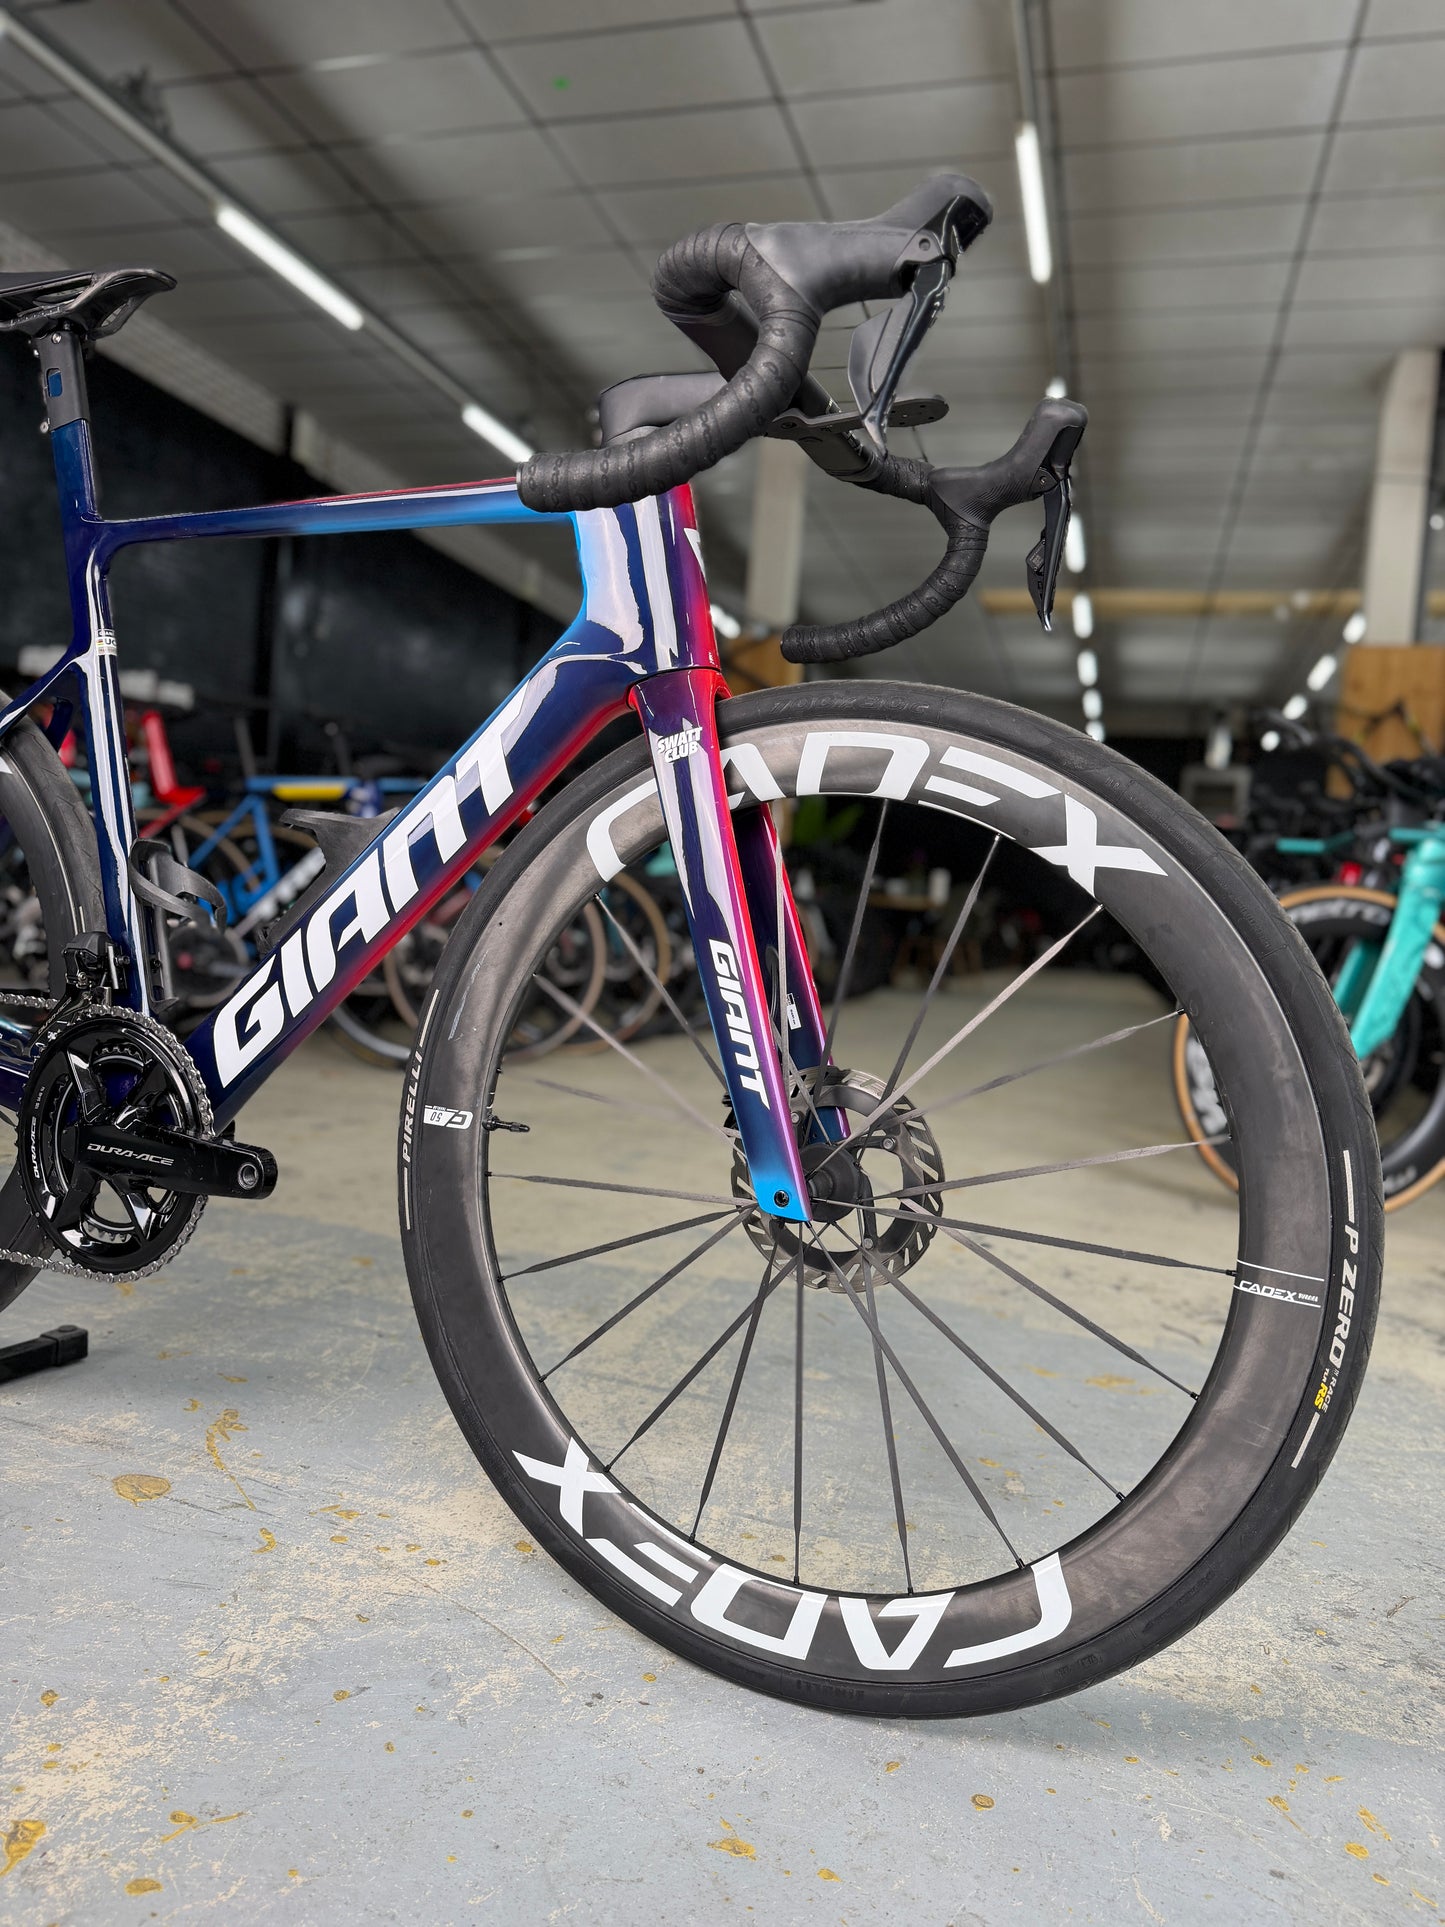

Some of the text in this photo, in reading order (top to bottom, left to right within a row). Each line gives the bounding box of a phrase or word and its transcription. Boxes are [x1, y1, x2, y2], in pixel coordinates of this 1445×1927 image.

[657, 726, 703, 754] SWATT
[664, 740, 699, 763] CLUB
[586, 731, 1168, 898] CADEX
[213, 679, 529, 1089] GIANT
[708, 938, 770, 1110] GIANT
[402, 1051, 423, 1163] PIRELLI
[430, 1111, 443, 1122] 50
[30, 1116, 40, 1179] DURA-ACE
[87, 1142, 175, 1166] DURA-ACE
[1239, 1280, 1298, 1302] CADEX
[1329, 1224, 1359, 1369] P ZERO
[1314, 1382, 1328, 1410] RS
[1321, 1376, 1337, 1413] RACE
[512, 1436, 1073, 1671] CADEX
